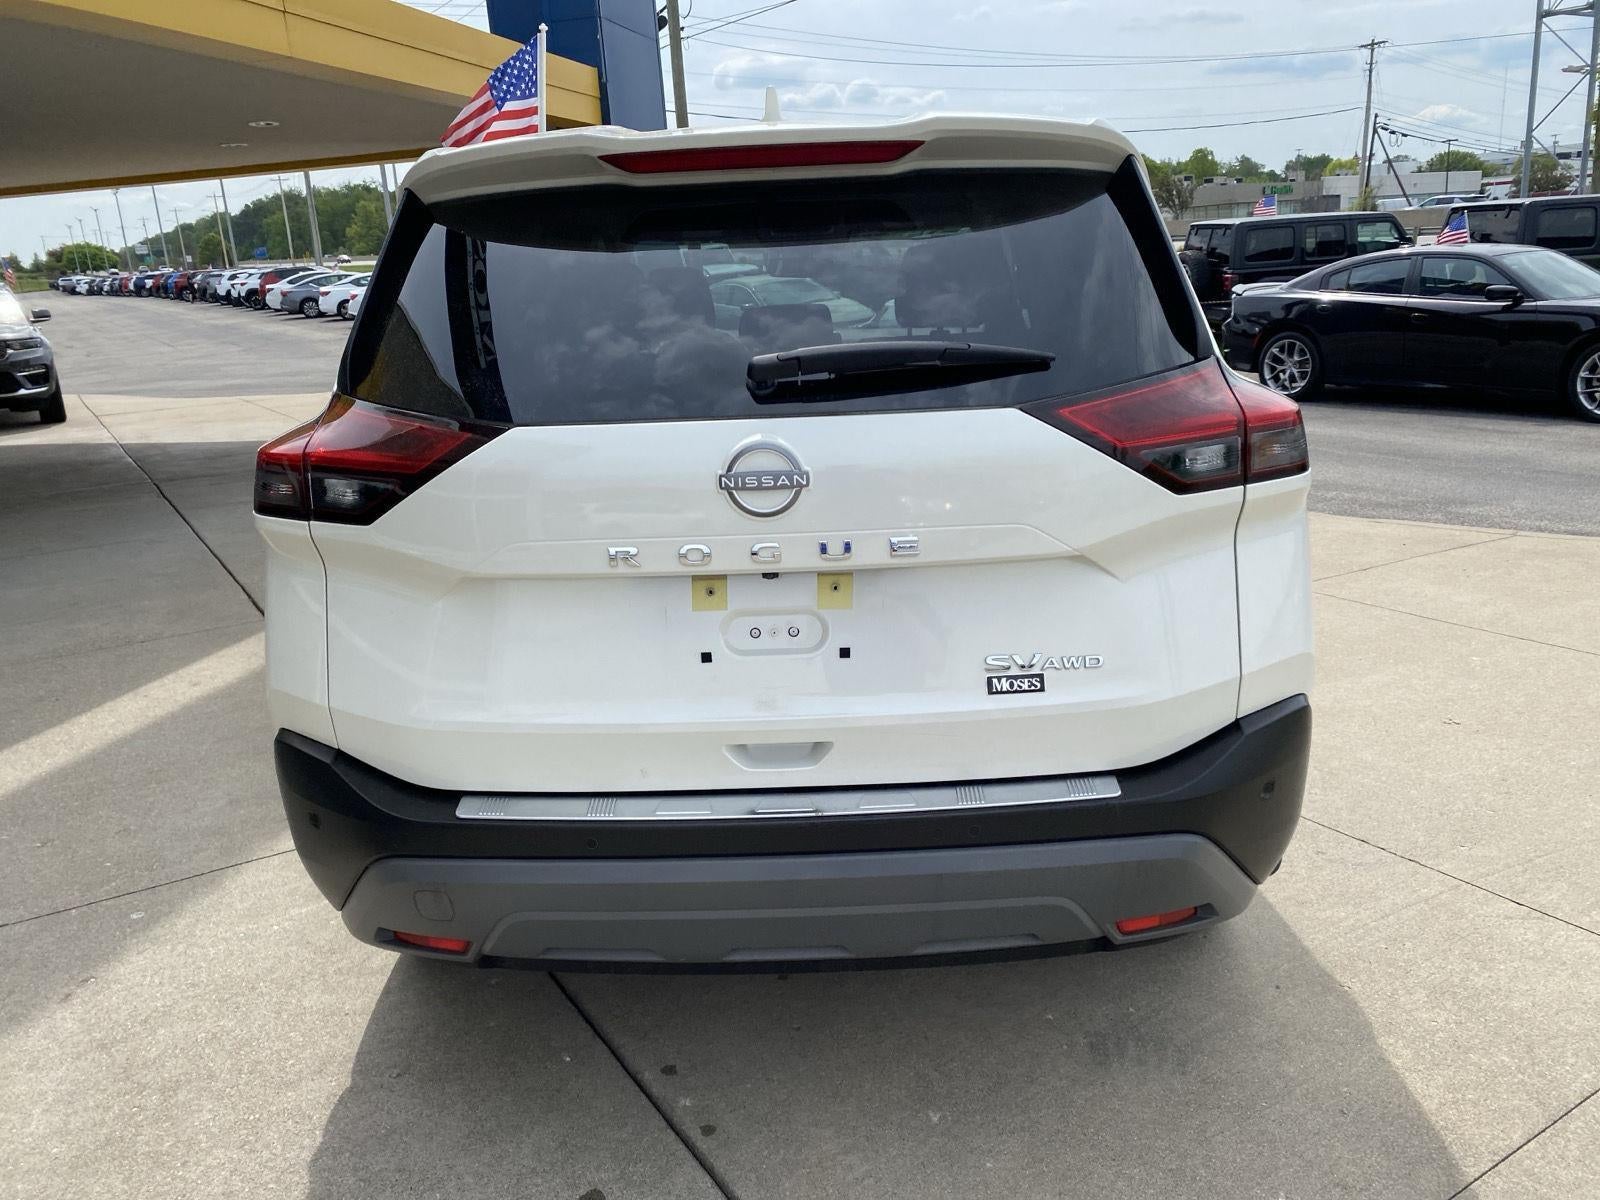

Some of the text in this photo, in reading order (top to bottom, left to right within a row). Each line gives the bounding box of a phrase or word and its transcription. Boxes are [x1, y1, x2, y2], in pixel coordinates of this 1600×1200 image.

[721, 474, 807, 488] NISSAN
[607, 535, 921, 568] ROGUE
[985, 653, 1104, 672] SV AWD
[991, 677, 1041, 692] MOSES
